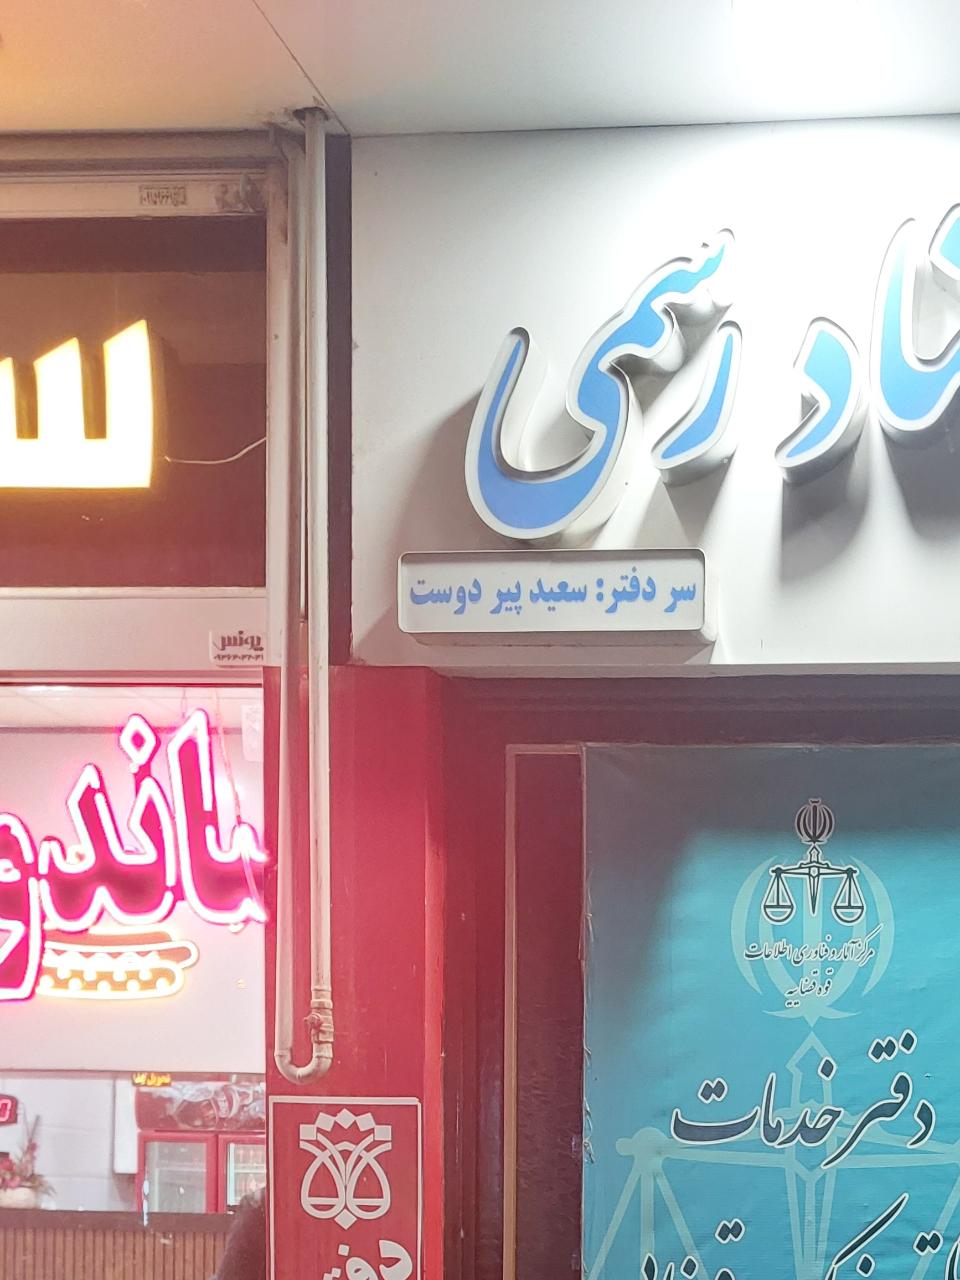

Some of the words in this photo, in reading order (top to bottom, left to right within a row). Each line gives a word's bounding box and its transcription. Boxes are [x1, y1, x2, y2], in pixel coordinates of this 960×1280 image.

[464, 226, 742, 541] رسمی
[410, 578, 482, 615] دوست
[490, 580, 522, 615] پیر
[529, 578, 588, 612] سعید
[664, 581, 697, 613] سر
[744, 938, 792, 961] اطلاعات
[792, 934, 832, 966] فناوری
[856, 923, 884, 966] مرکز
[817, 967, 833, 995] قوه
[671, 1056, 845, 1148] خدمات
[821, 1029, 936, 1169] دفتر
